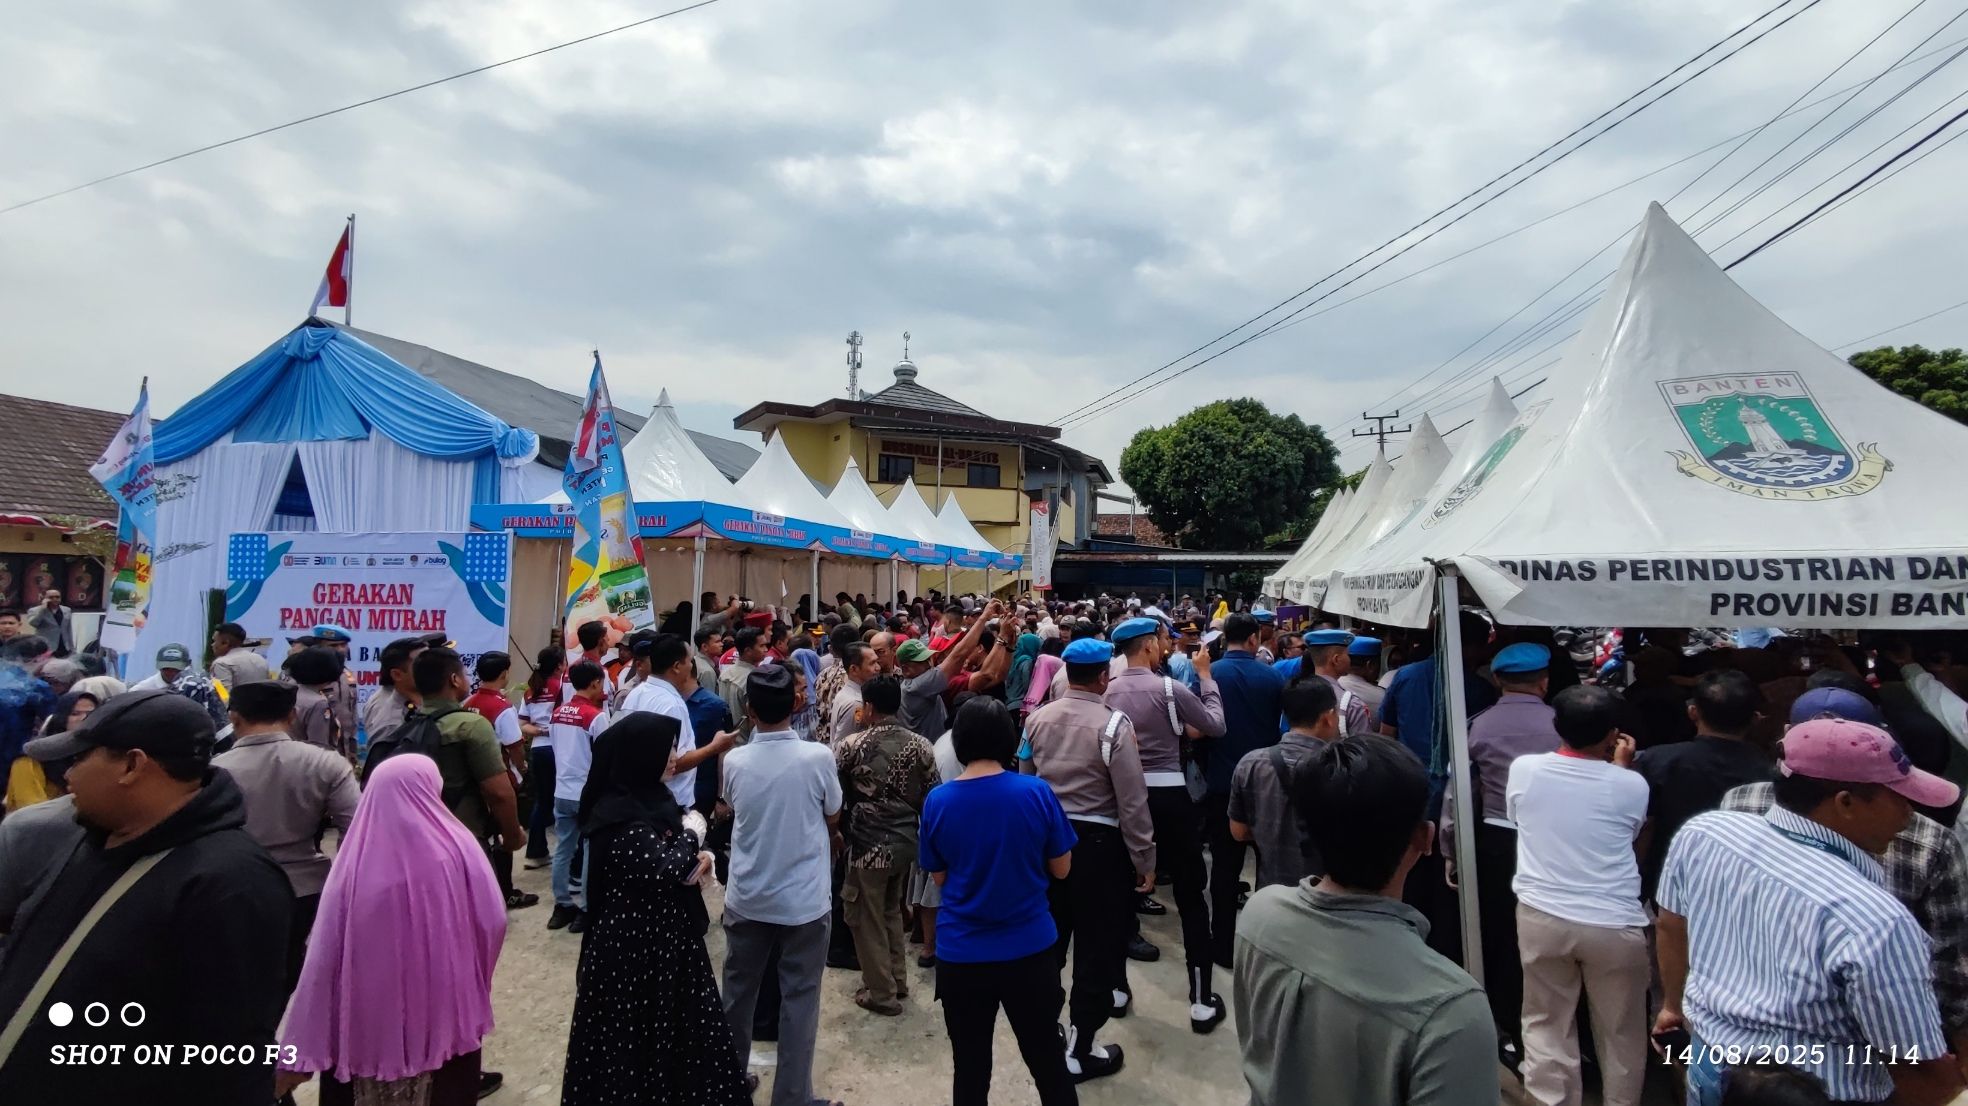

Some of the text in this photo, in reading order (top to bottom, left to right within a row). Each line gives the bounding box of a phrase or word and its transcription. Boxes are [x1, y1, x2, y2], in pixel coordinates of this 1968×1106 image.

[1673, 376, 1793, 396] BANTEN
[1713, 471, 1878, 500] IMAN TAQWA
[639, 515, 667, 528] RAH
[1499, 559, 1598, 582] DINAS
[1607, 557, 1896, 582] PERINDUSTRIAN
[312, 582, 415, 605] GERAKAN
[1710, 592, 1968, 617] PROVINSI BAN
[279, 607, 447, 632] PANGAN MURAH
